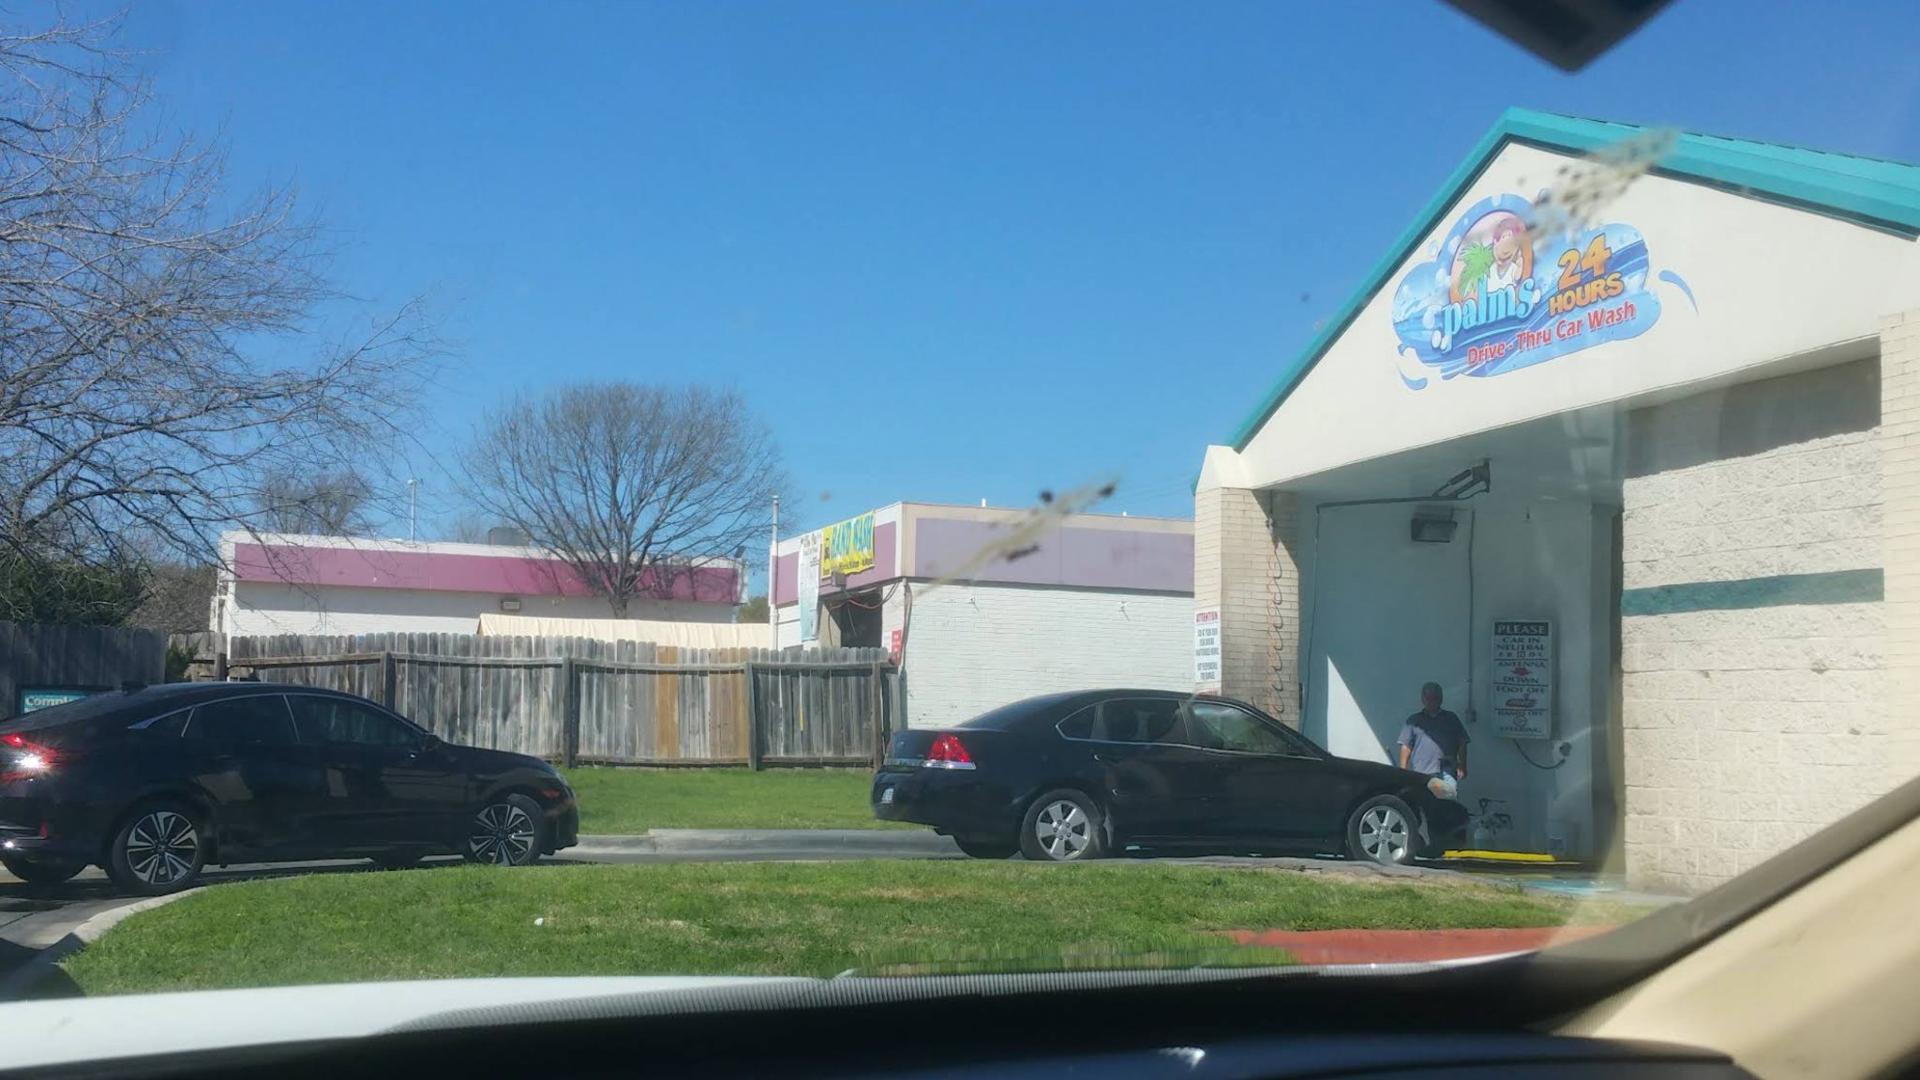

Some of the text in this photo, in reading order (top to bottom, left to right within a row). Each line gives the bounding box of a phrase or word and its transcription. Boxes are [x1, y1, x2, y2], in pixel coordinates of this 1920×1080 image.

[1557, 233, 1612, 291] 24
[1442, 277, 1536, 343] palms
[1550, 272, 1624, 315] HOURS
[1516, 326, 1553, 353] Thru
[1555, 318, 1584, 340] Car
[1588, 301, 1636, 329] Wash
[1496, 623, 1546, 635] PLEASE
[1503, 676, 1539, 684] DOWN
